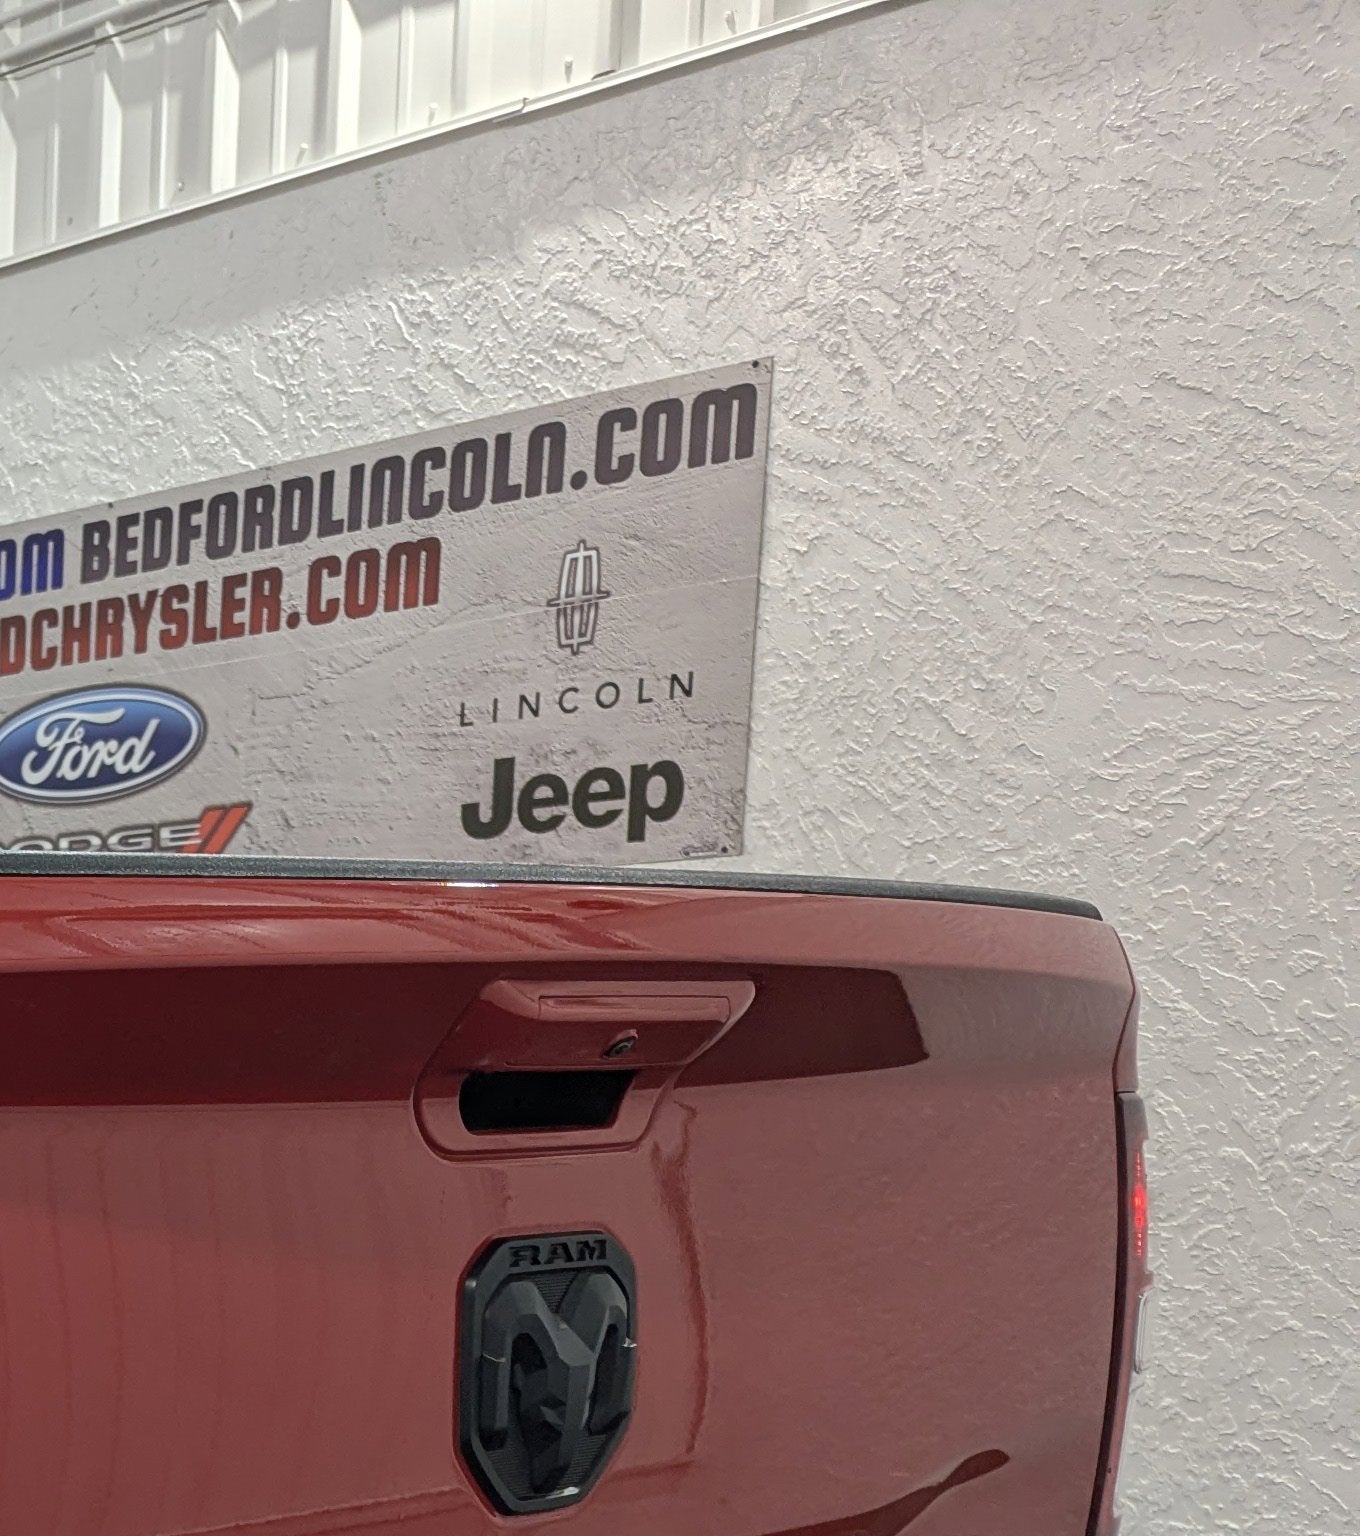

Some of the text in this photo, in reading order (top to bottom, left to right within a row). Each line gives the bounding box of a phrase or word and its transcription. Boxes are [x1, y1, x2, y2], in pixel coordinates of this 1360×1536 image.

[80, 382, 759, 584] BEDFORDLINCOLN.COM
[458, 670, 697, 728] LINCOLN
[20, 705, 155, 785] Ford
[461, 757, 684, 843] Jeep
[508, 1239, 608, 1268] RAM
